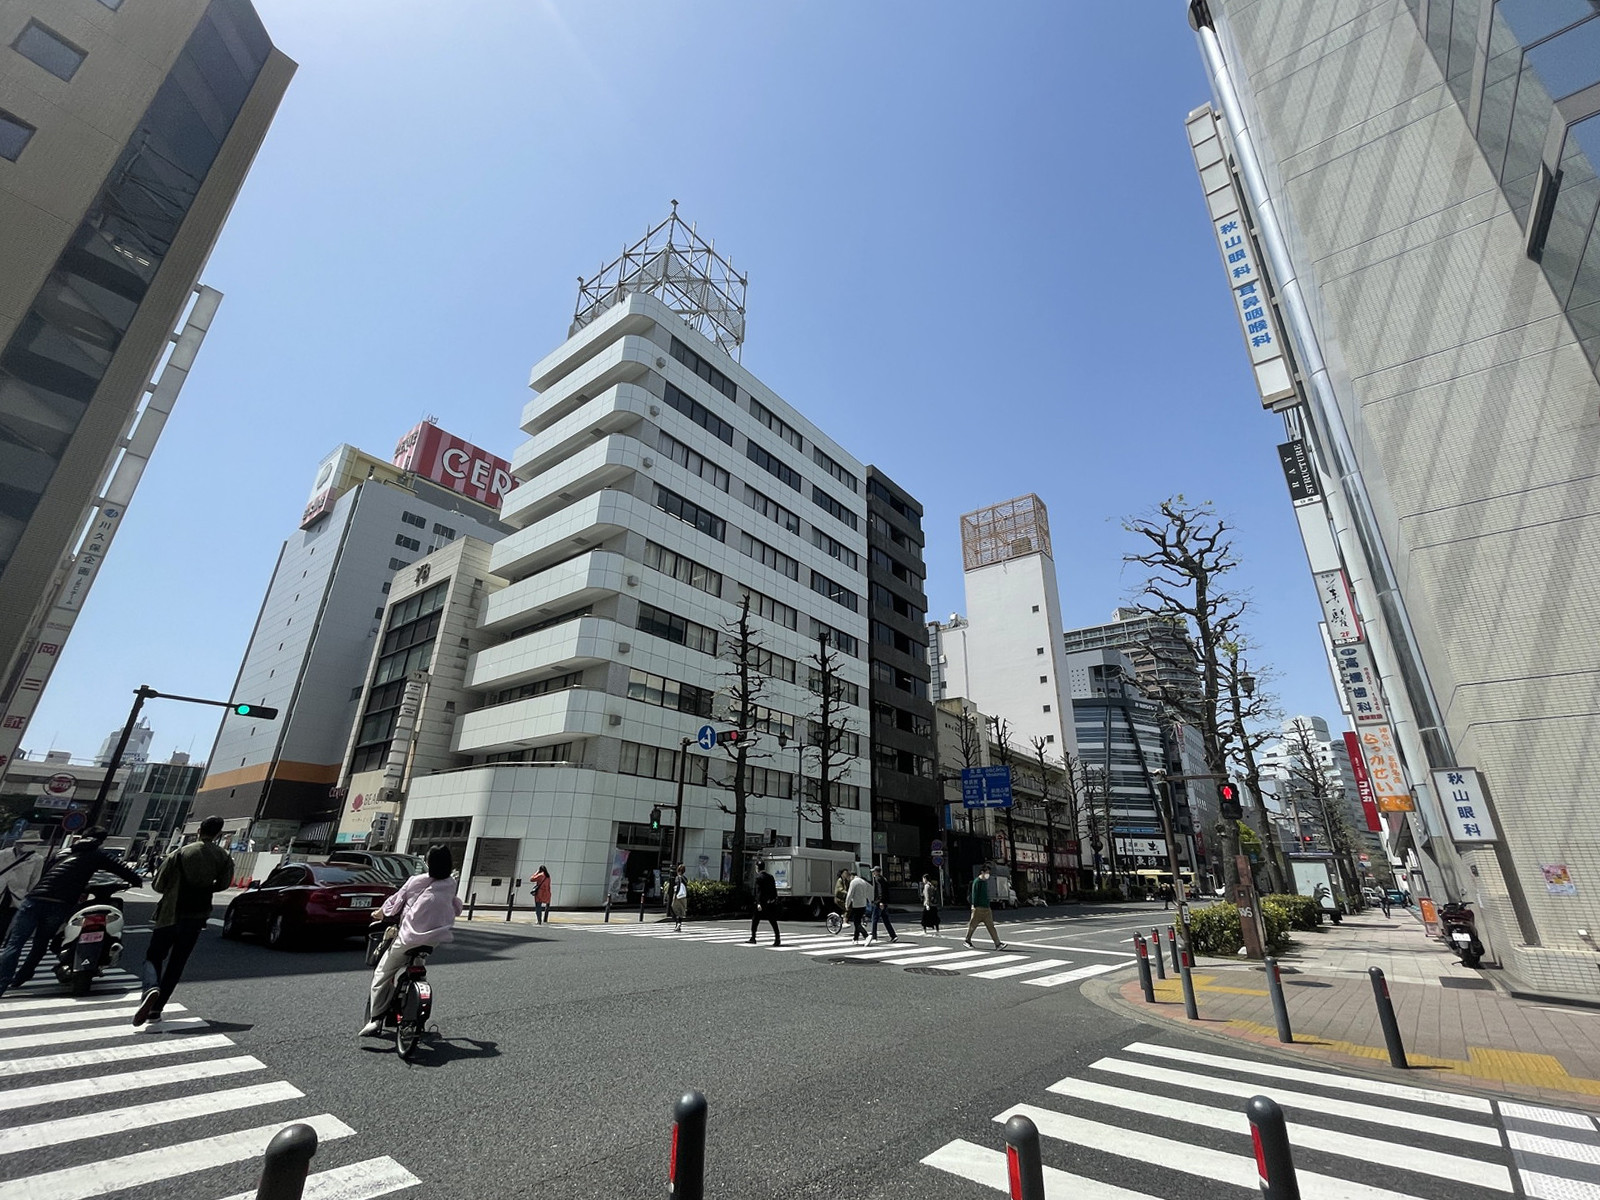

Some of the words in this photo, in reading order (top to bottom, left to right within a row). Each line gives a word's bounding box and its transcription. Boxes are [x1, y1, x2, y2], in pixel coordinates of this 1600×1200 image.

[1220, 220, 1252, 279] 秋山眼科
[1283, 455, 1300, 488] RAY
[1293, 443, 1315, 495] STRUCTURE
[1363, 732, 1394, 792] らっかせい
[1358, 780, 1372, 803] コナカ
[1446, 772, 1481, 837] 秋山眼科
